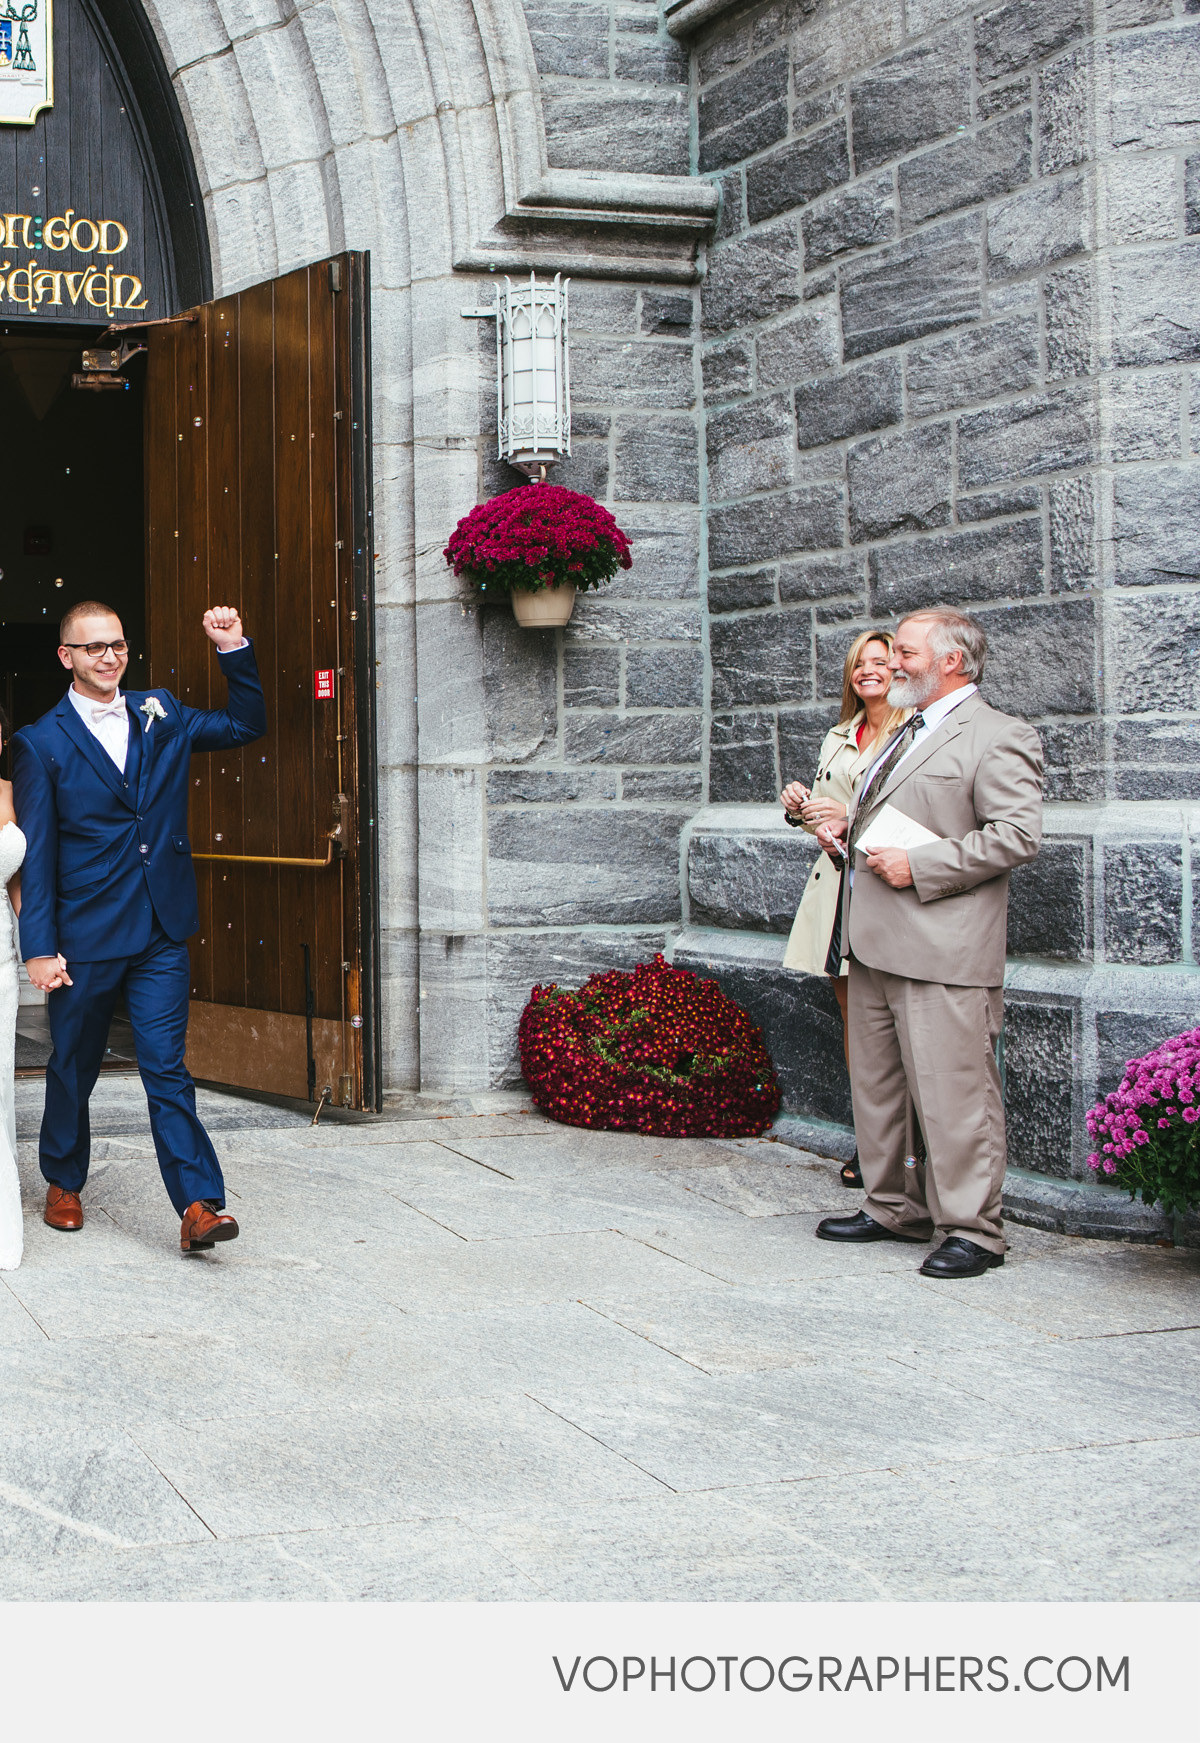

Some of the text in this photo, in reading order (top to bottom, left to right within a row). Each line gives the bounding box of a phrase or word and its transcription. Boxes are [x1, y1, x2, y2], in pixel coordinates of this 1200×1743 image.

[43, 209, 129, 254] GOD
[318, 671, 329, 679] EXIT
[318, 680, 330, 688] THIS
